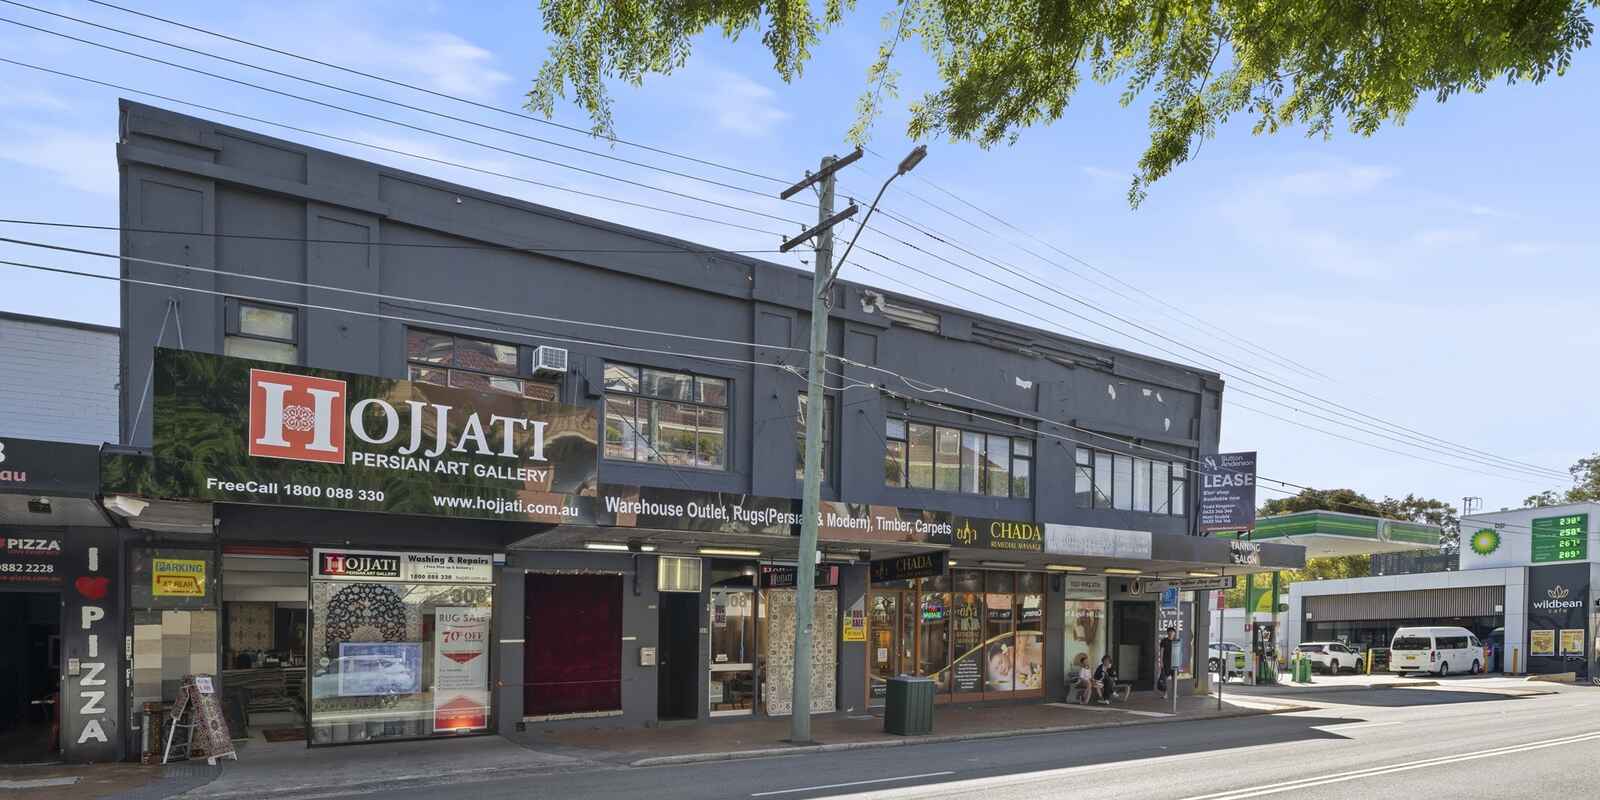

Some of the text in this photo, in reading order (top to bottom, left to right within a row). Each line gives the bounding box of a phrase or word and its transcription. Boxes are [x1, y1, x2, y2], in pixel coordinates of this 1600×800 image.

[256, 381, 548, 461] HOJJATI
[352, 452, 547, 482] PERSIAN ART GALLERY
[1204, 473, 1253, 488] LEASE
[207, 478, 385, 502] FreeCall 1800 088 330
[433, 495, 579, 517] www.hojjati.com.au
[605, 496, 683, 517] Warehouse
[687, 502, 729, 521] Outlet,
[827, 512, 873, 532] Modern),
[876, 516, 913, 534] Timber,
[915, 519, 952, 536] Carpets
[991, 521, 1041, 540] CHADA
[8, 538, 61, 550] PIZZA
[1231, 541, 1261, 552] TANNING
[325, 556, 398, 573] HOJJATI
[408, 555, 445, 564] Washing
[457, 557, 488, 565] Repairs
[1234, 553, 1257, 565] SALON
[0, 564, 54, 573] 882 2228
[1533, 600, 1583, 609] wildbean
[439, 614, 460, 623] RUG
[77, 547, 108, 743] I PIZZA
